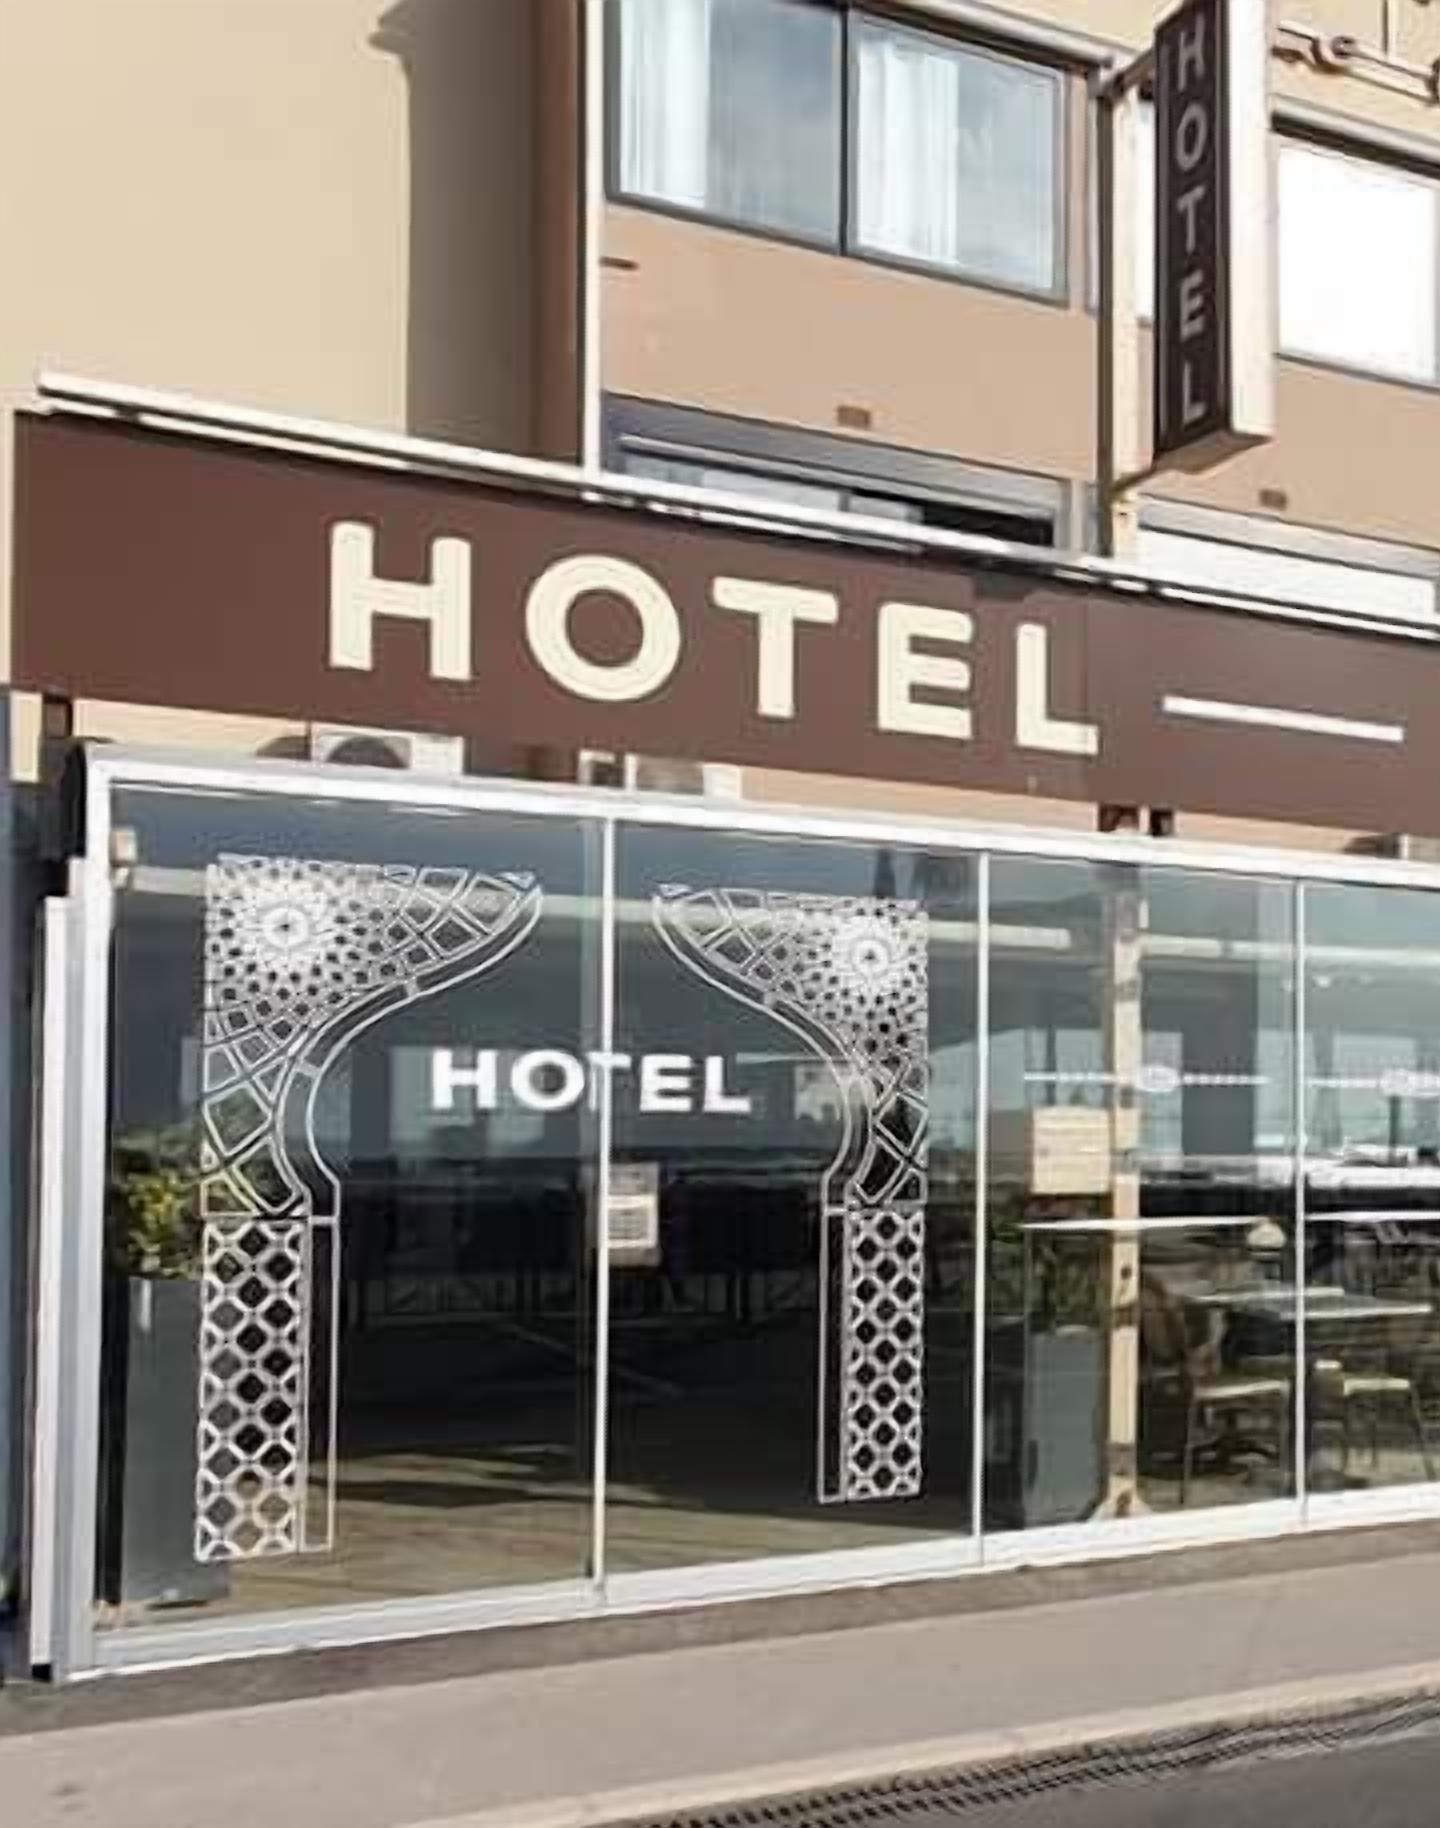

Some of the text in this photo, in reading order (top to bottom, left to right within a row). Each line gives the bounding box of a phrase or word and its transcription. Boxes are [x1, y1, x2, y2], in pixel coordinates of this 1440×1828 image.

[1175, 15, 1209, 426] HOTEL
[328, 520, 1099, 756] HOTEL
[431, 1048, 752, 1112] HOTEL
